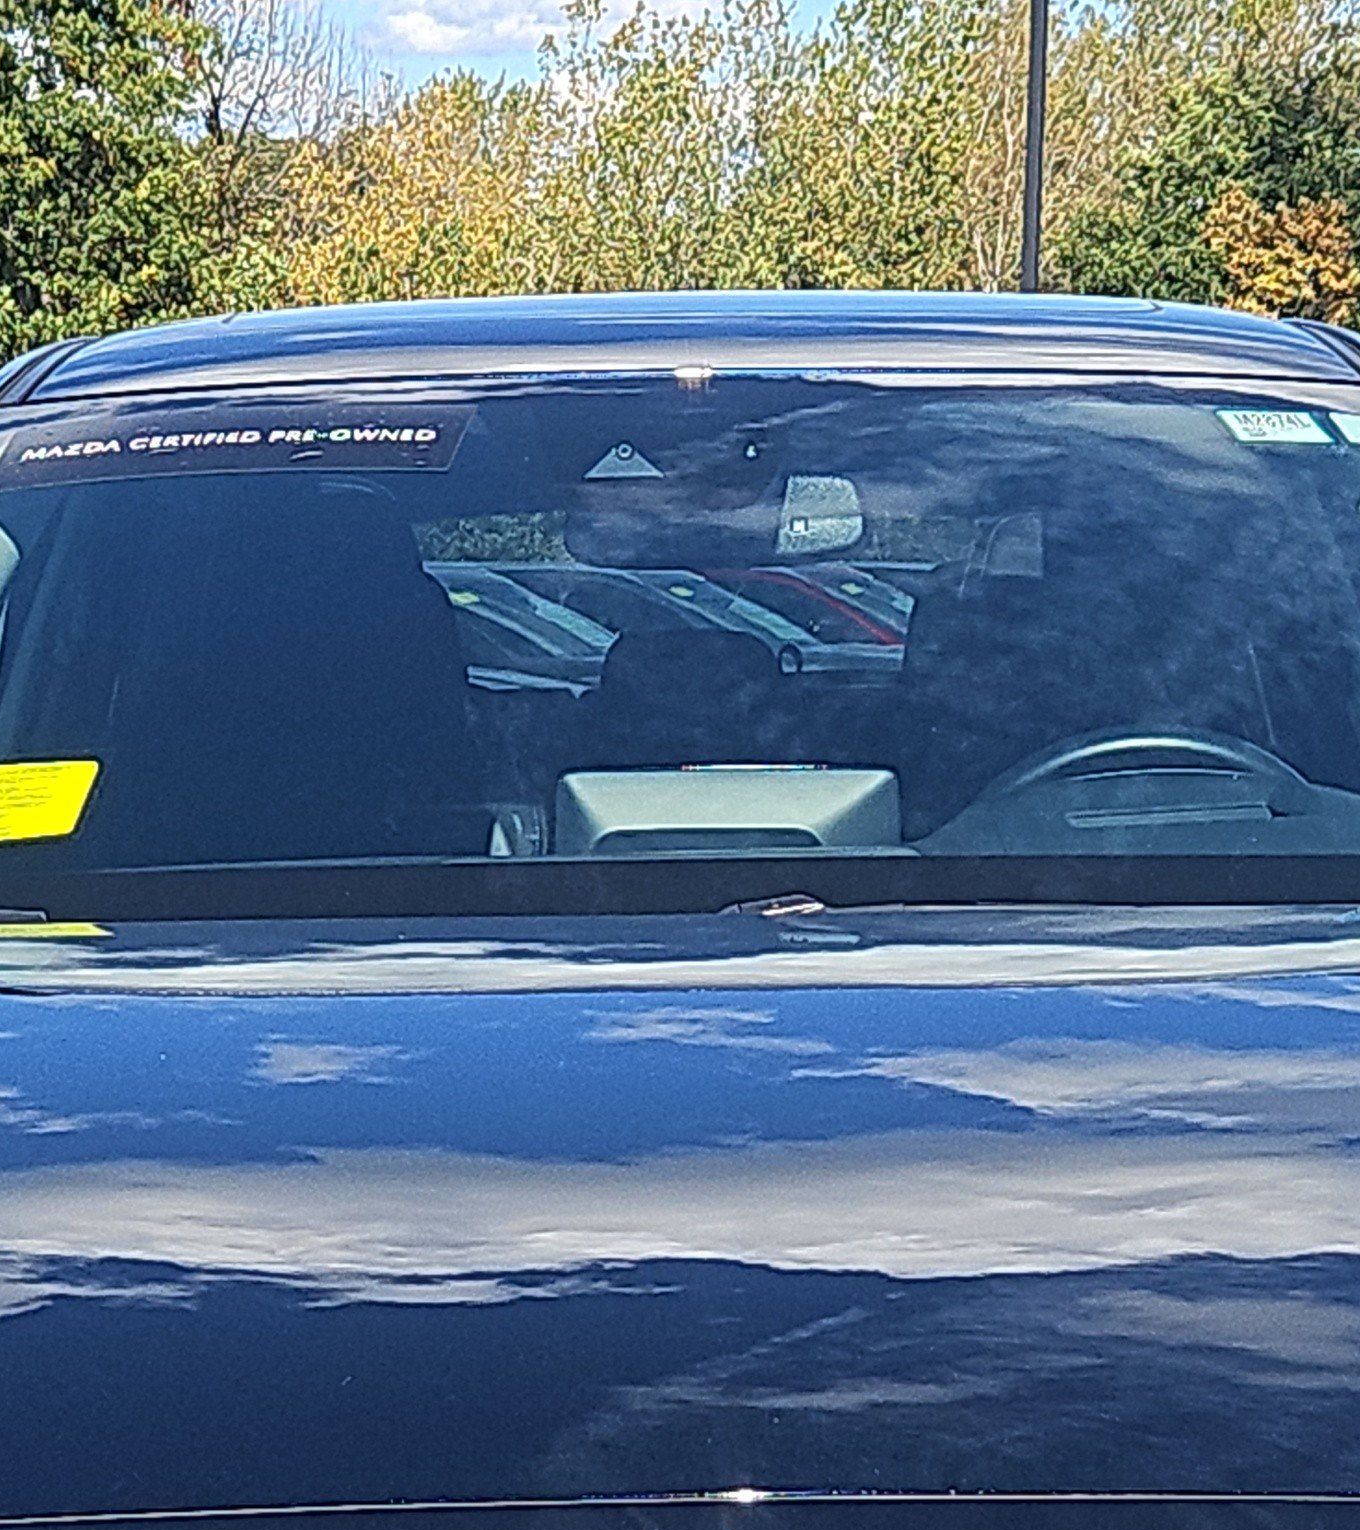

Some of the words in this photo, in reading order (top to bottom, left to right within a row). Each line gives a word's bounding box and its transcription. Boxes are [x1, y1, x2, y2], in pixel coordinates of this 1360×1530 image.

[20, 439, 121, 461] MAZDA
[128, 430, 262, 451] CERTIFIED
[267, 428, 437, 443] PRE-OWNED
